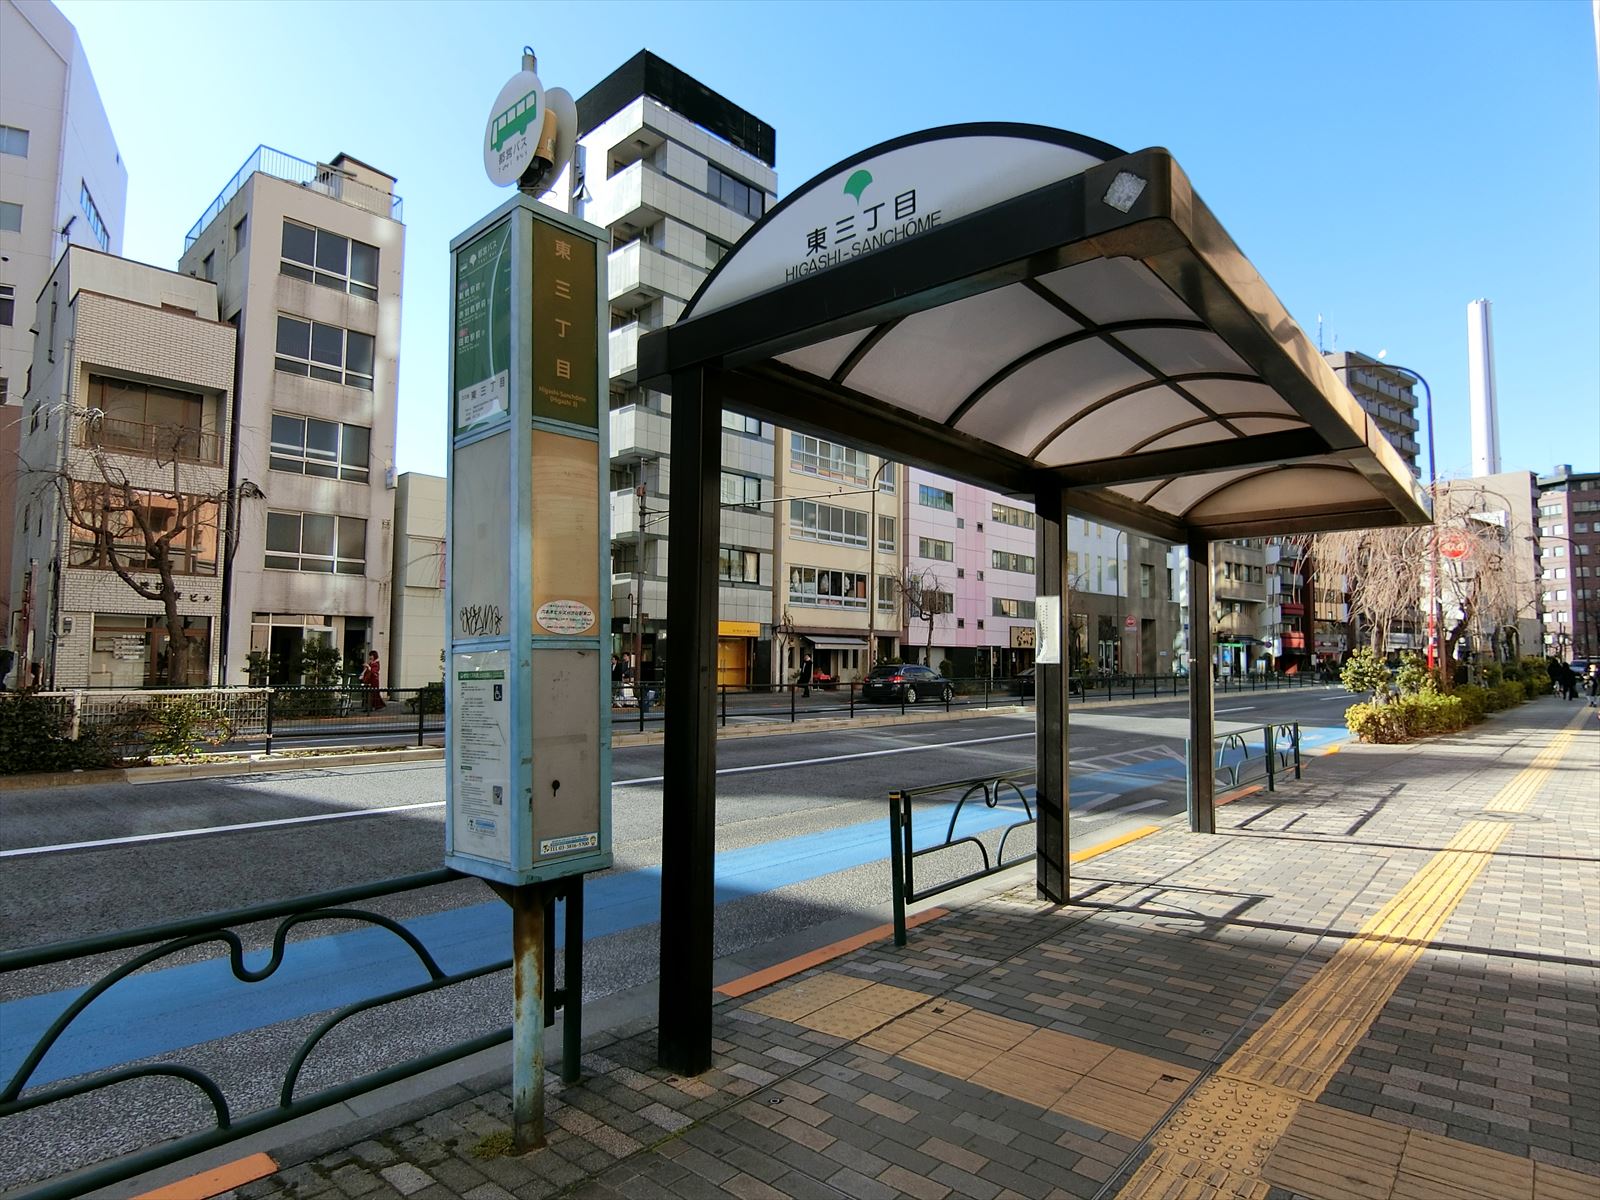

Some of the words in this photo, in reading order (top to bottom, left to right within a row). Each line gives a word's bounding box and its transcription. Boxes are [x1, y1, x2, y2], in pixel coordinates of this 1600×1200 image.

[806, 188, 917, 258] 東三丁目
[554, 239, 572, 380] 東三丁目
[470, 376, 505, 400] 東三丁目
